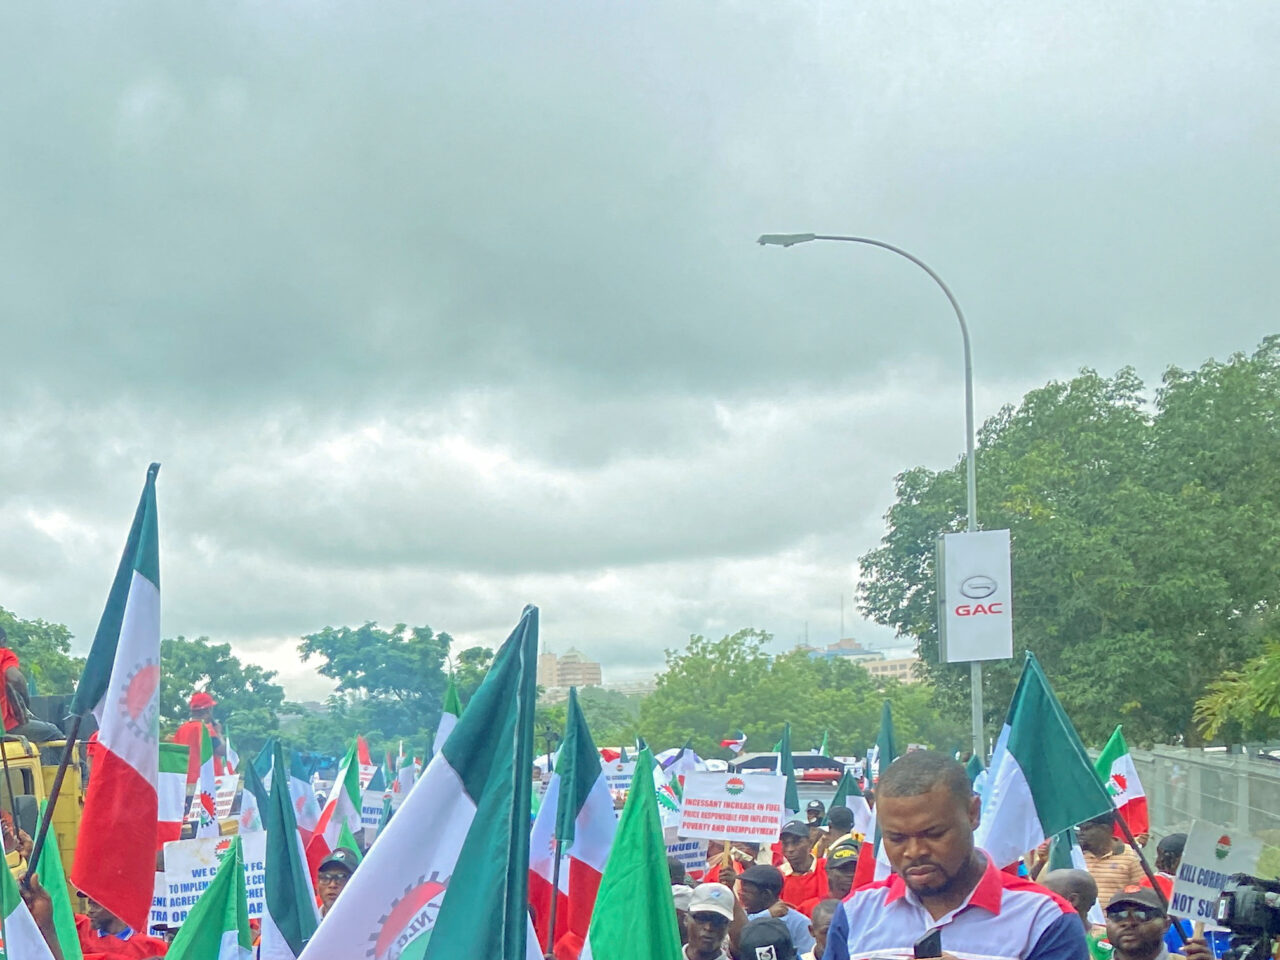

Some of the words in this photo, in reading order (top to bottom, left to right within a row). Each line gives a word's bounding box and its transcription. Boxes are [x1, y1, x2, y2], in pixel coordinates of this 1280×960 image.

[955, 602, 1003, 616] GAC
[685, 798, 722, 808] INCESSANT
[724, 802, 756, 810] INCREASE
[766, 804, 780, 812] FUEL
[684, 810, 700, 818] PRICE
[682, 822, 710, 831] POVERTY
[712, 824, 725, 832] AND
[726, 825, 777, 835] UNEMPLOYMENT
[192, 868, 207, 878] WE
[1180, 863, 1197, 883] KILL
[169, 884, 178, 894] TO
[1172, 893, 1194, 913] NOT
